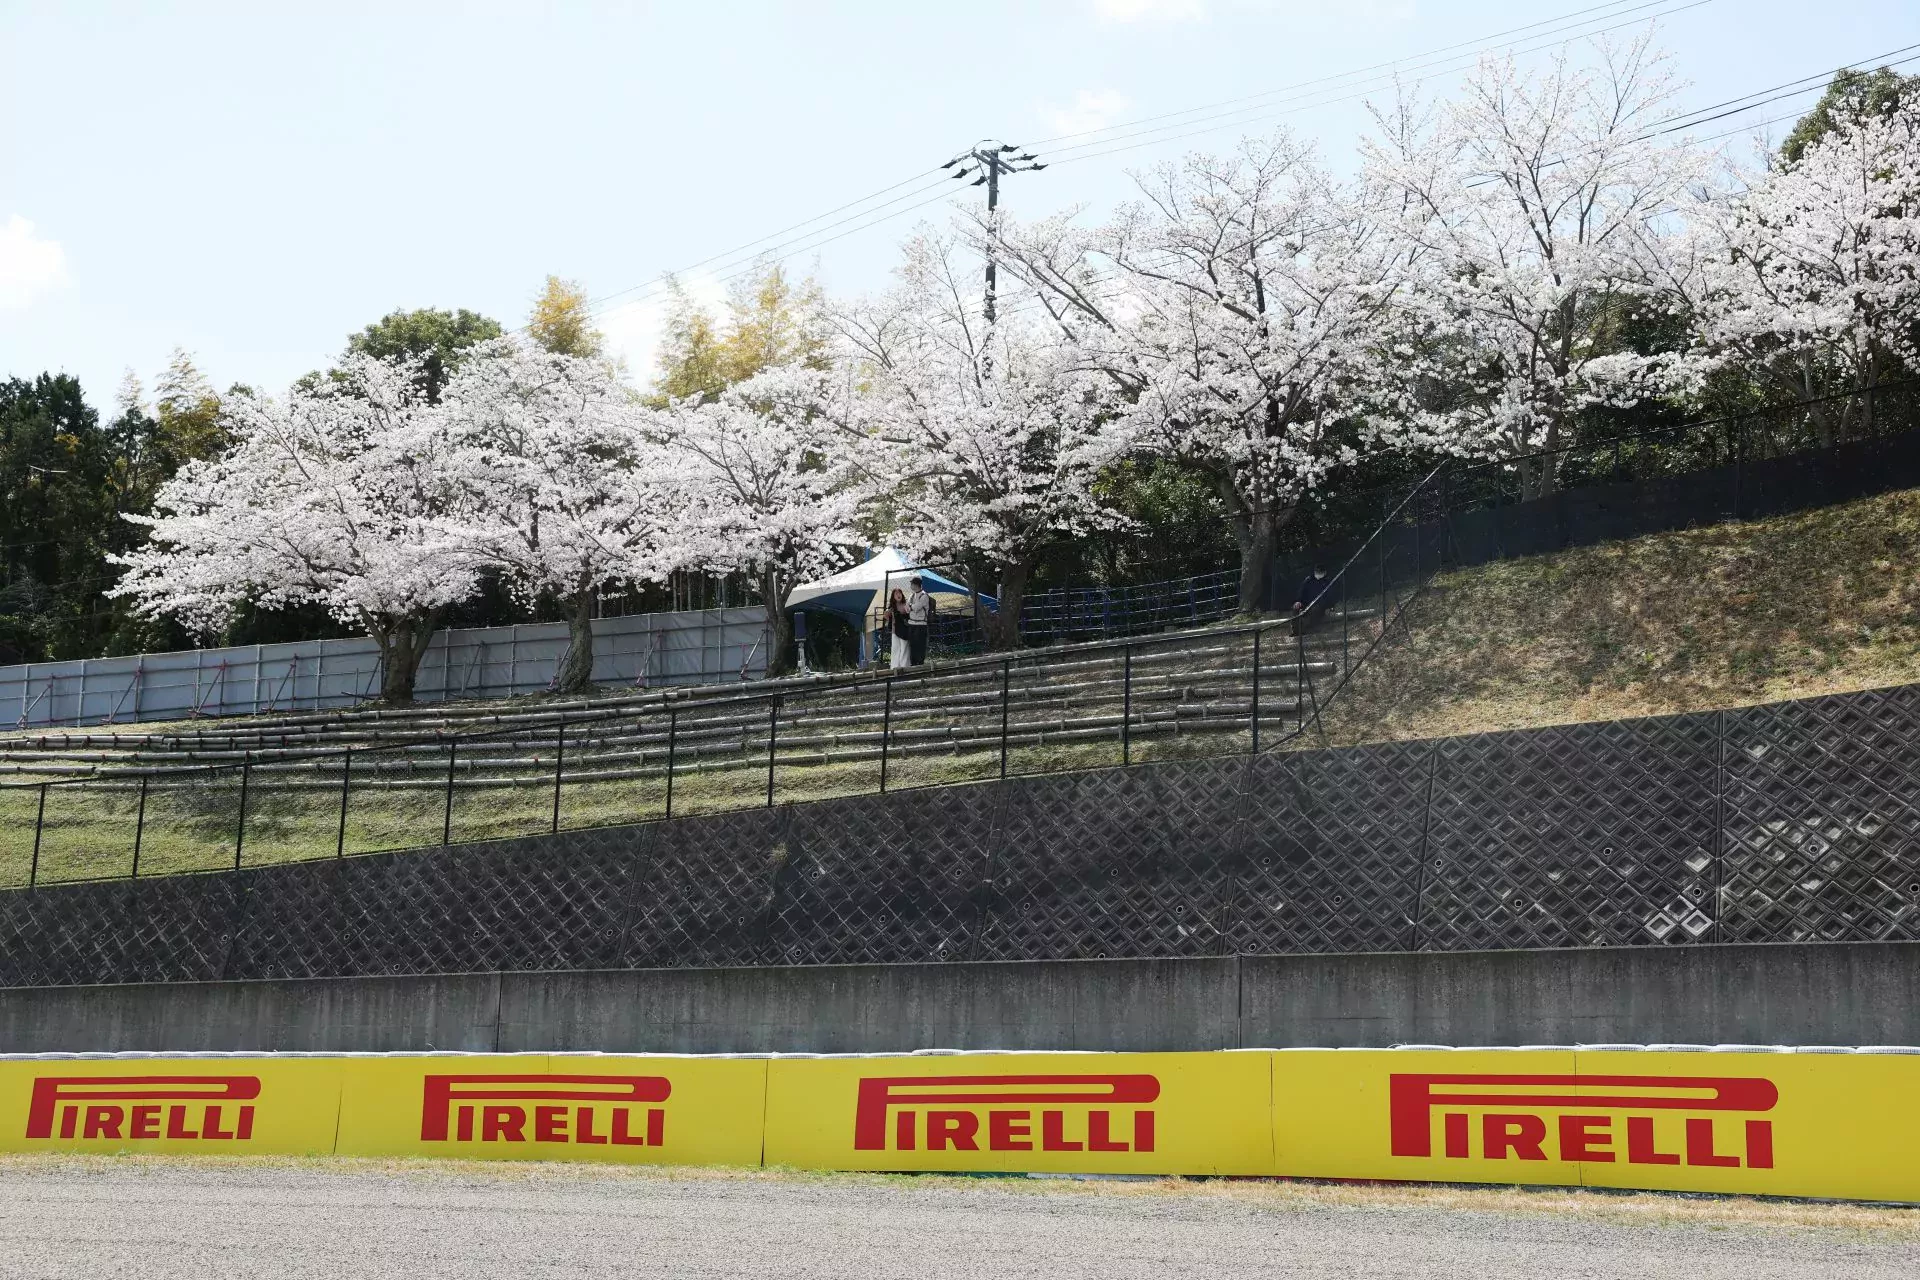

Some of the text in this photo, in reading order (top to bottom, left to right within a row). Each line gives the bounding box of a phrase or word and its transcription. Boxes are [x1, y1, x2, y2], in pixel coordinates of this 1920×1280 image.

[26, 1076, 261, 1139] PIRELLI
[421, 1075, 671, 1146] PIRELLI
[855, 1074, 1160, 1152] PIRELLI
[1390, 1073, 1778, 1169] PIRELLI
